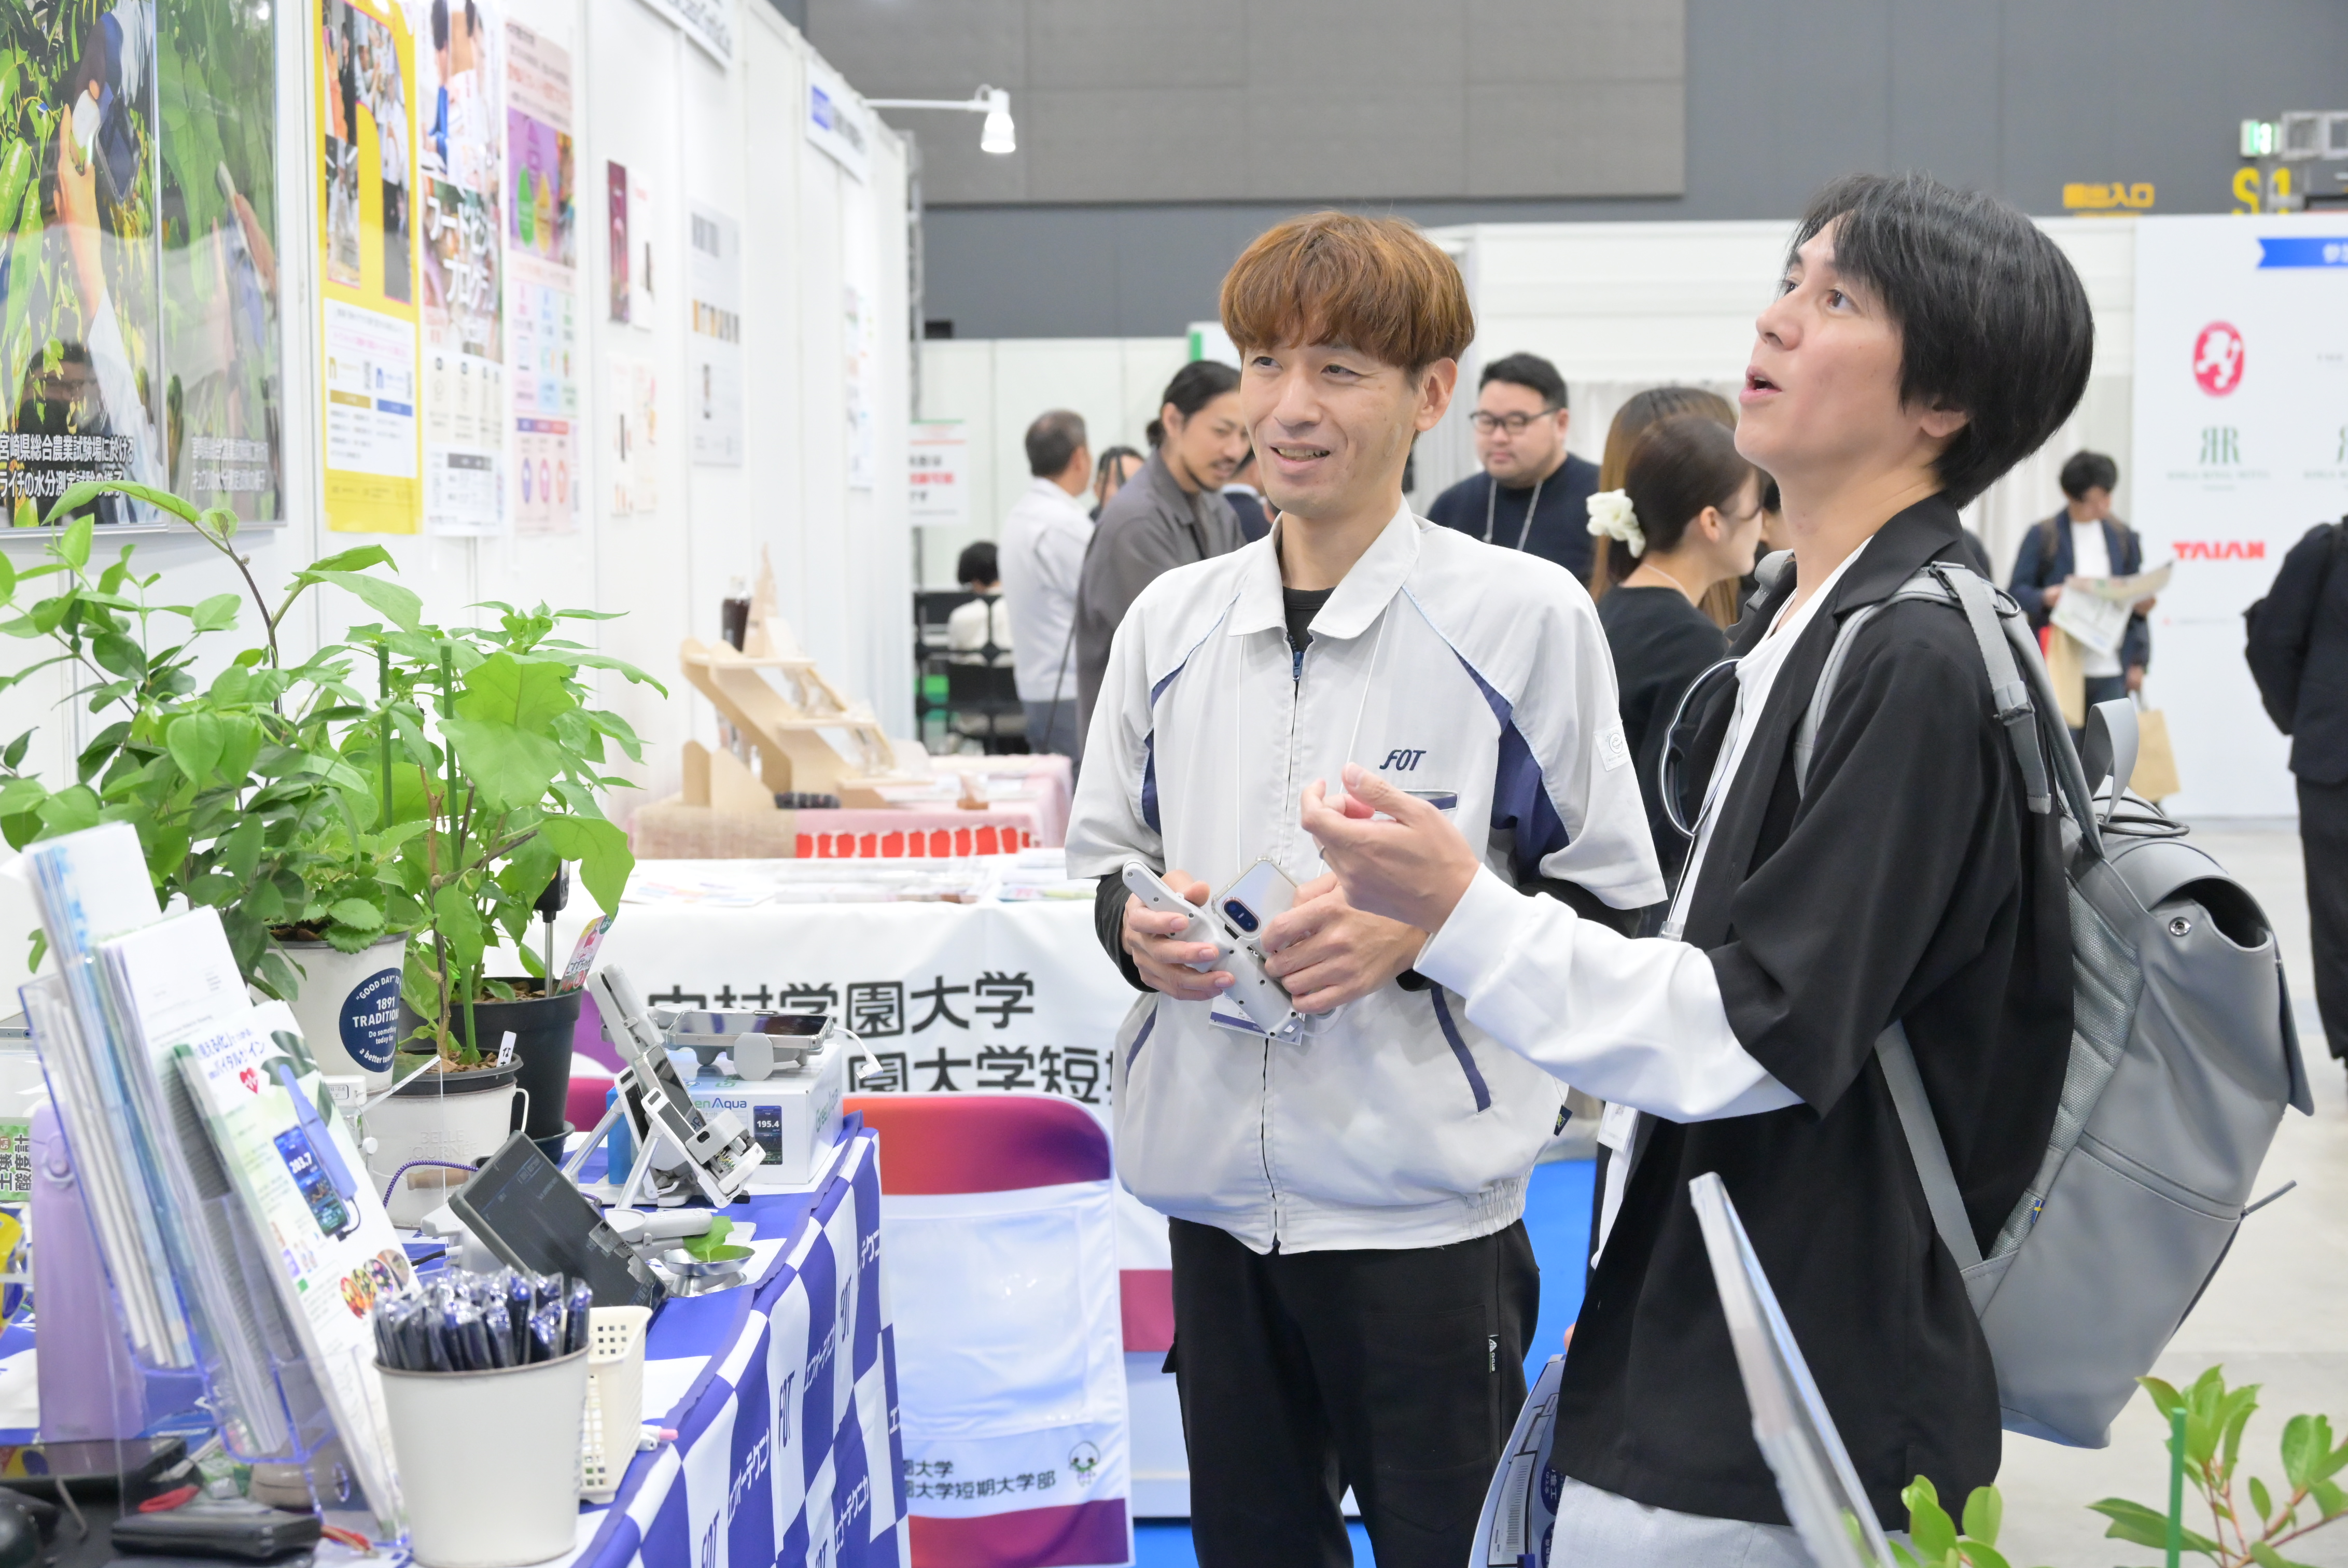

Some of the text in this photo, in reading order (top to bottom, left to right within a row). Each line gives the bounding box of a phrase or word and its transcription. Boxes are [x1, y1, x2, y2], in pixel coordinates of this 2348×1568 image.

[0, 434, 135, 463] 宮崎県総合農業試験場に於ける
[2173, 541, 2266, 559] TAIAN
[1379, 749, 1427, 771] FOT
[376, 996, 395, 1011] 1891
[352, 1008, 399, 1028] TRADITION
[375, 1036, 388, 1044] today
[378, 1026, 397, 1036] something
[365, 1049, 382, 1063] better
[848, 1045, 1116, 1104] 園大学短
[421, 1130, 464, 1144] BELLE
[778, 1370, 795, 1454] FOT
[889, 1404, 901, 1435] エ
